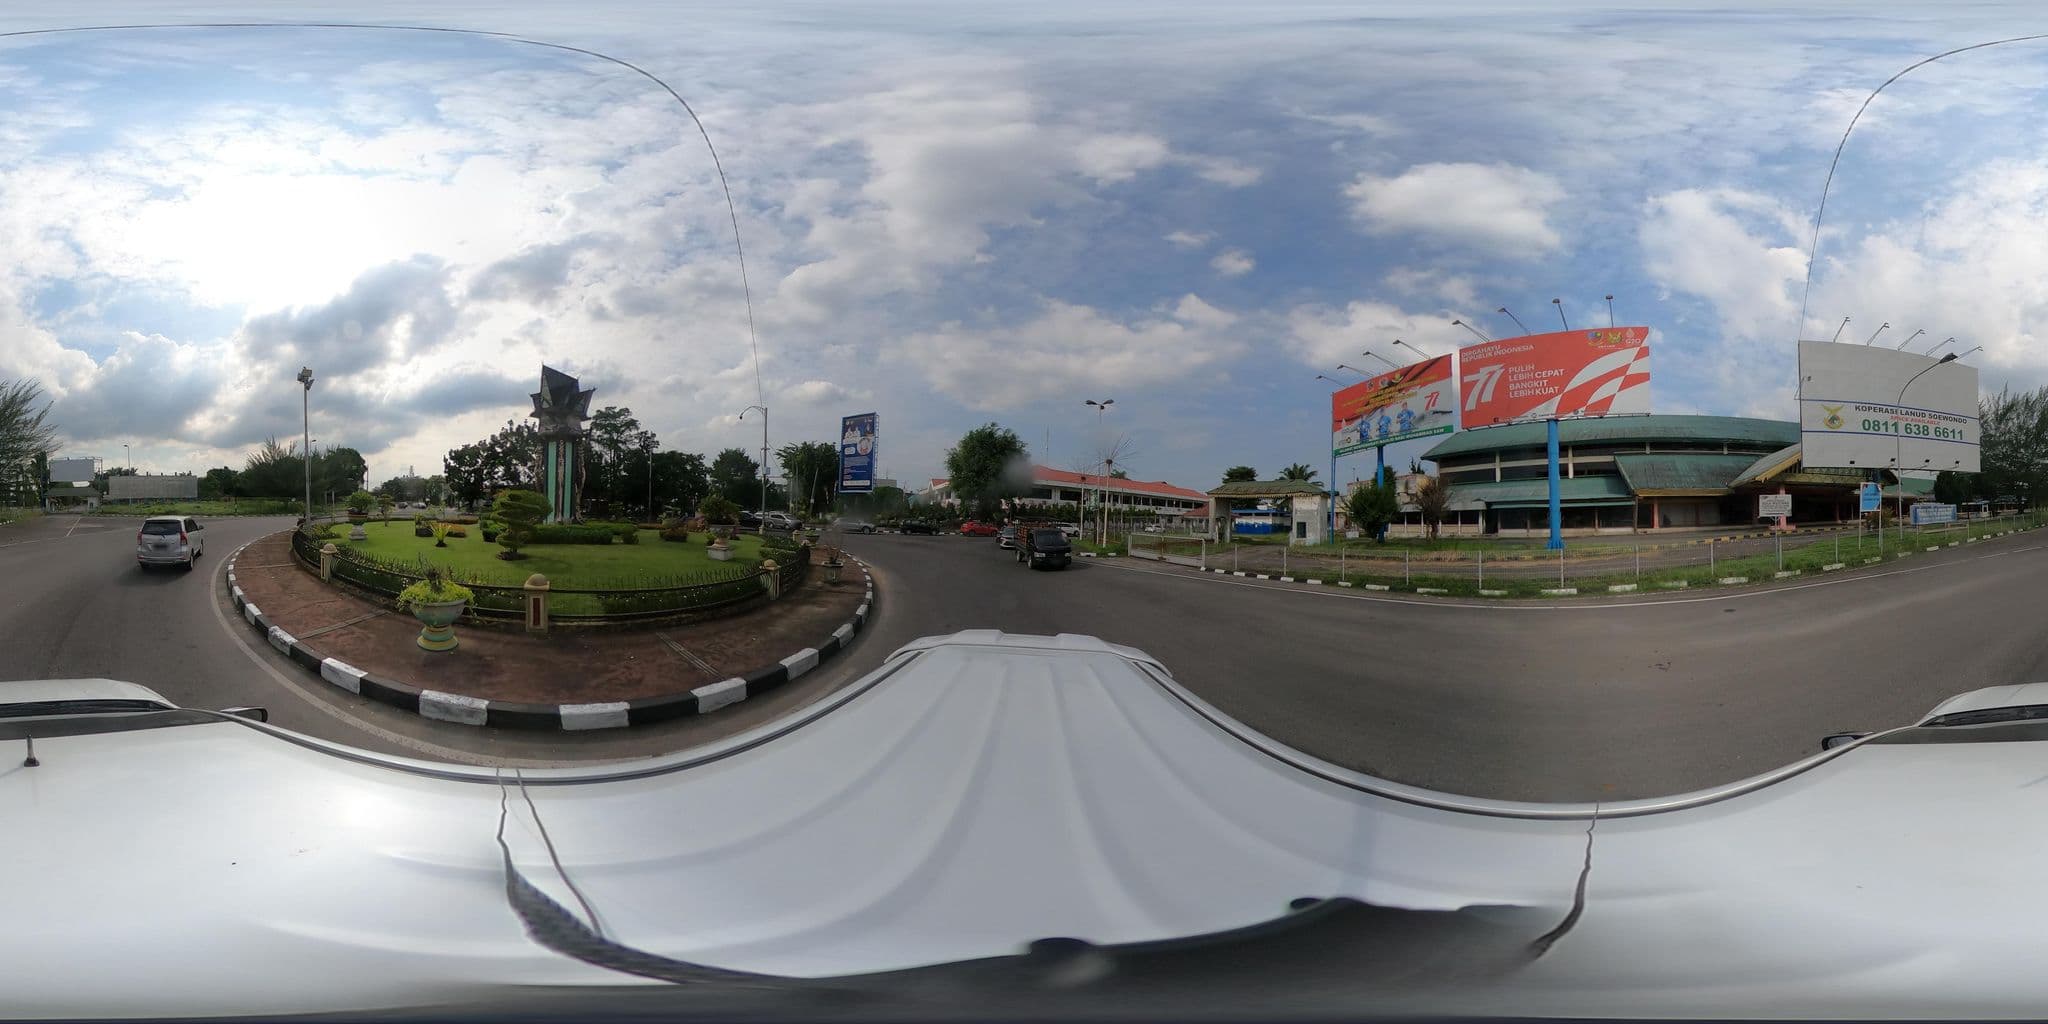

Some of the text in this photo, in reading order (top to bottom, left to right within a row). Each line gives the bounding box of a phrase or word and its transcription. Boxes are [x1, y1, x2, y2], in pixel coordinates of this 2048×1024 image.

[1462, 344, 1535, 363] REPUBLIK INDONESIA
[1509, 364, 1535, 374] PULIH
[1509, 368, 1565, 382] LEBIH CEPAT
[1463, 363, 1505, 411] 77
[1509, 380, 1549, 391] BANGKIT
[1509, 386, 1560, 398] LEBIH KUAT
[1854, 404, 1968, 425] KOPERASI LANUD SOEWONDO
[1862, 419, 1964, 441] 0811 638 6611
